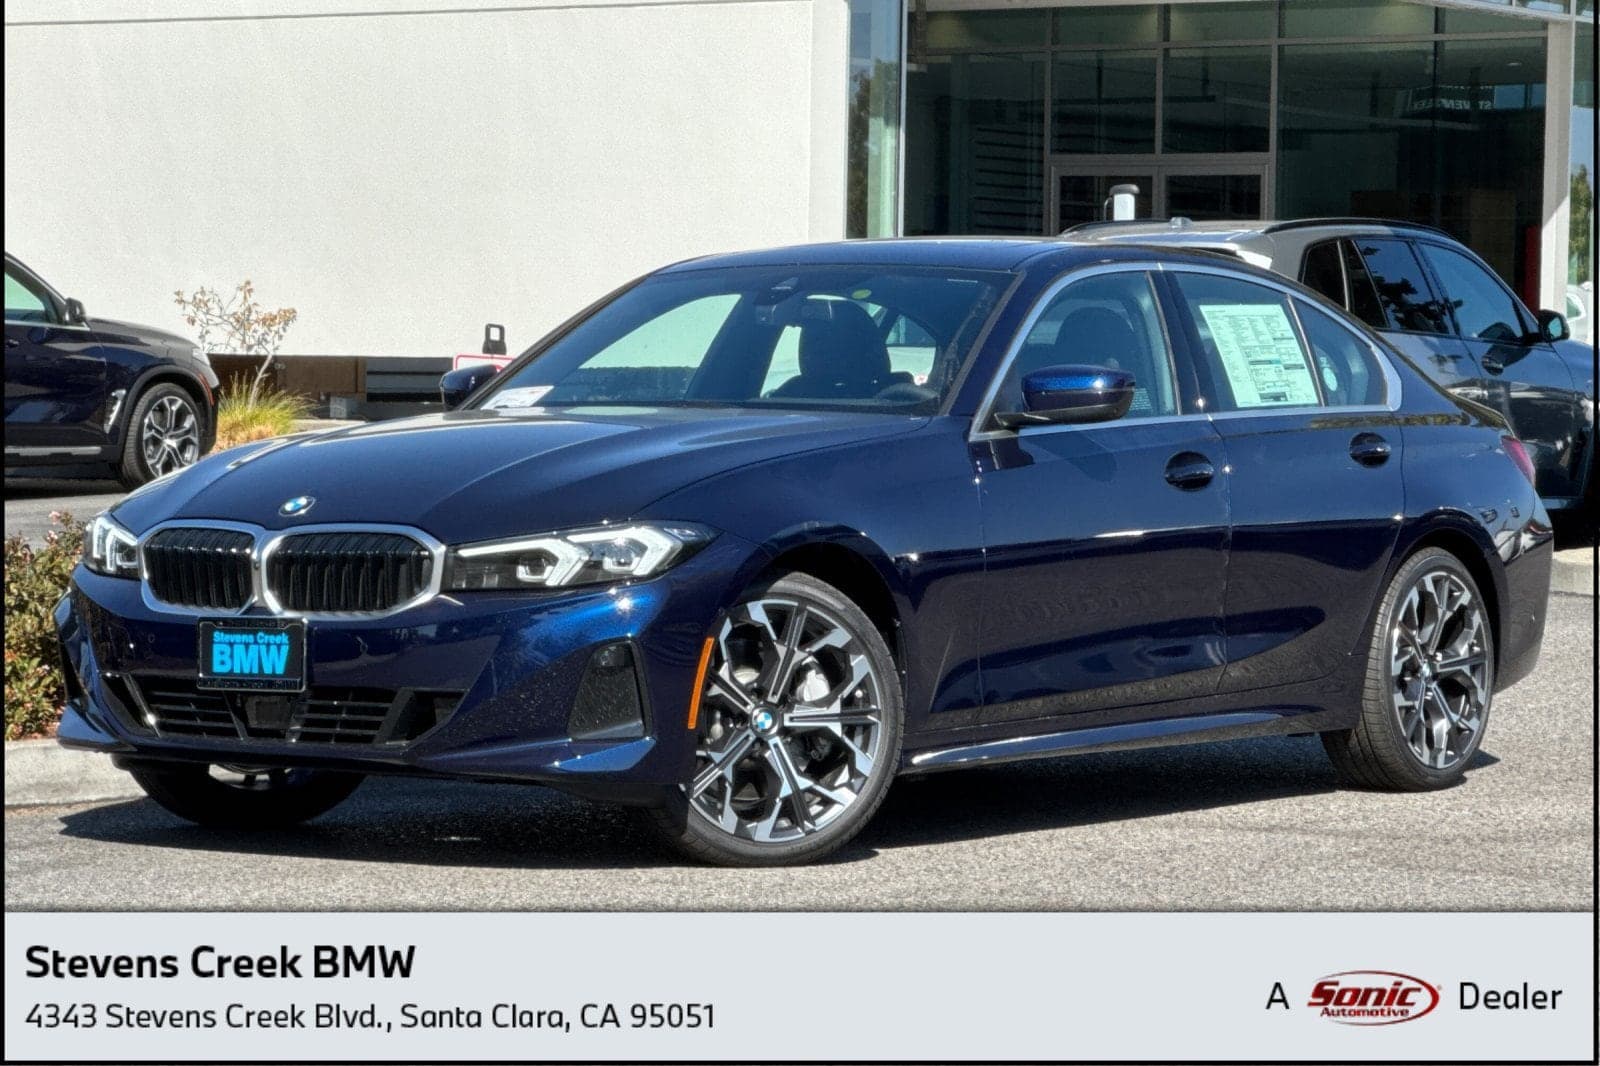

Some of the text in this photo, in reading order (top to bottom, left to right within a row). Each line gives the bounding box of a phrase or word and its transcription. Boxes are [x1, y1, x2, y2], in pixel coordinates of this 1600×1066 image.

[213, 631, 289, 644] Stevens Creek
[212, 643, 290, 675] BMW
